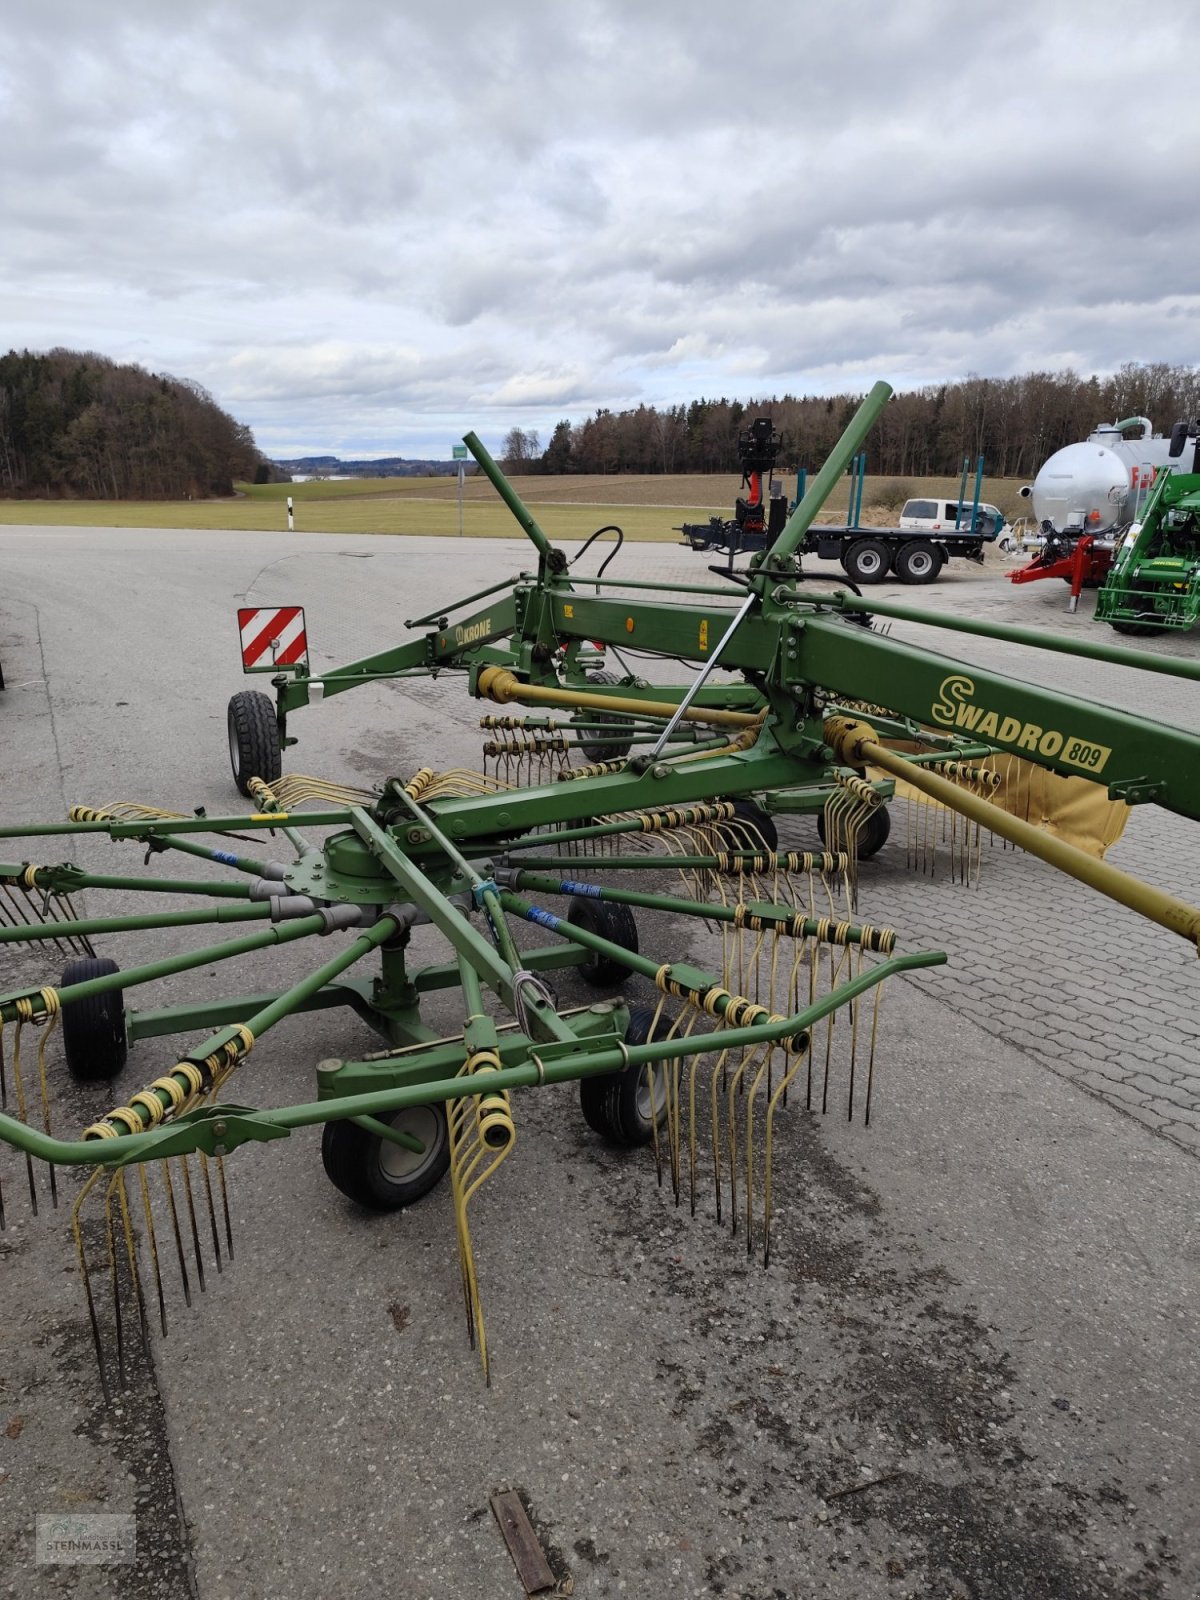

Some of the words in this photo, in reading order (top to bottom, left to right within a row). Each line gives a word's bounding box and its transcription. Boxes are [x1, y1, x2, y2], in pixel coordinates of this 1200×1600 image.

[463, 617, 491, 644] KRONE
[931, 675, 1064, 757] SWADRO
[1068, 742, 1102, 767] 809
